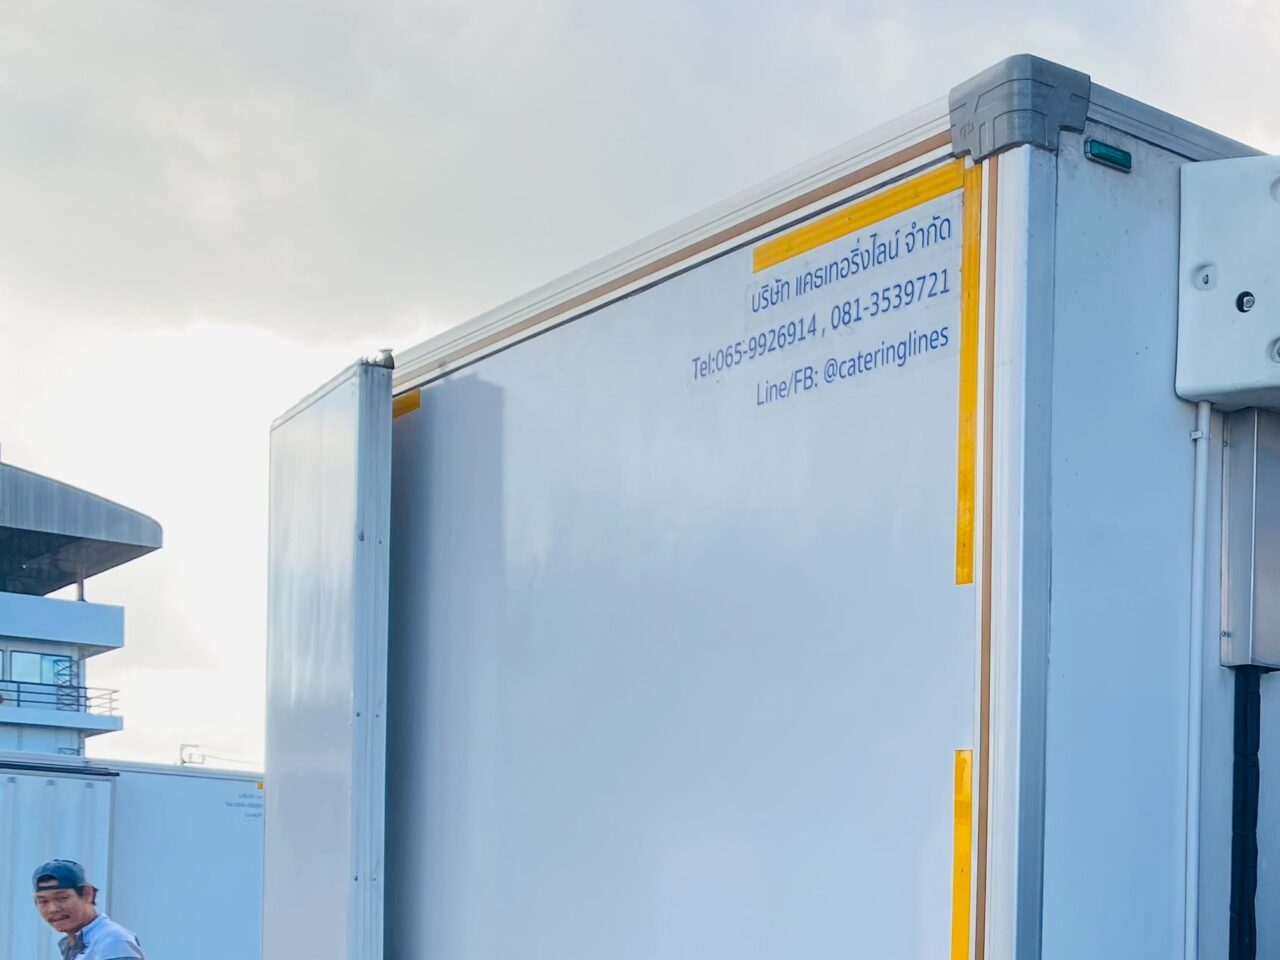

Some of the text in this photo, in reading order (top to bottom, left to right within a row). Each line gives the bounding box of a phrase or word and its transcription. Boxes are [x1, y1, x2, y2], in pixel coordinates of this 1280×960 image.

[752, 279, 790, 313] บริษัท
[905, 215, 951, 253] จำกัด
[831, 268, 950, 331] 081-3539721
[756, 326, 949, 406] Line/FB: @cateringlines
